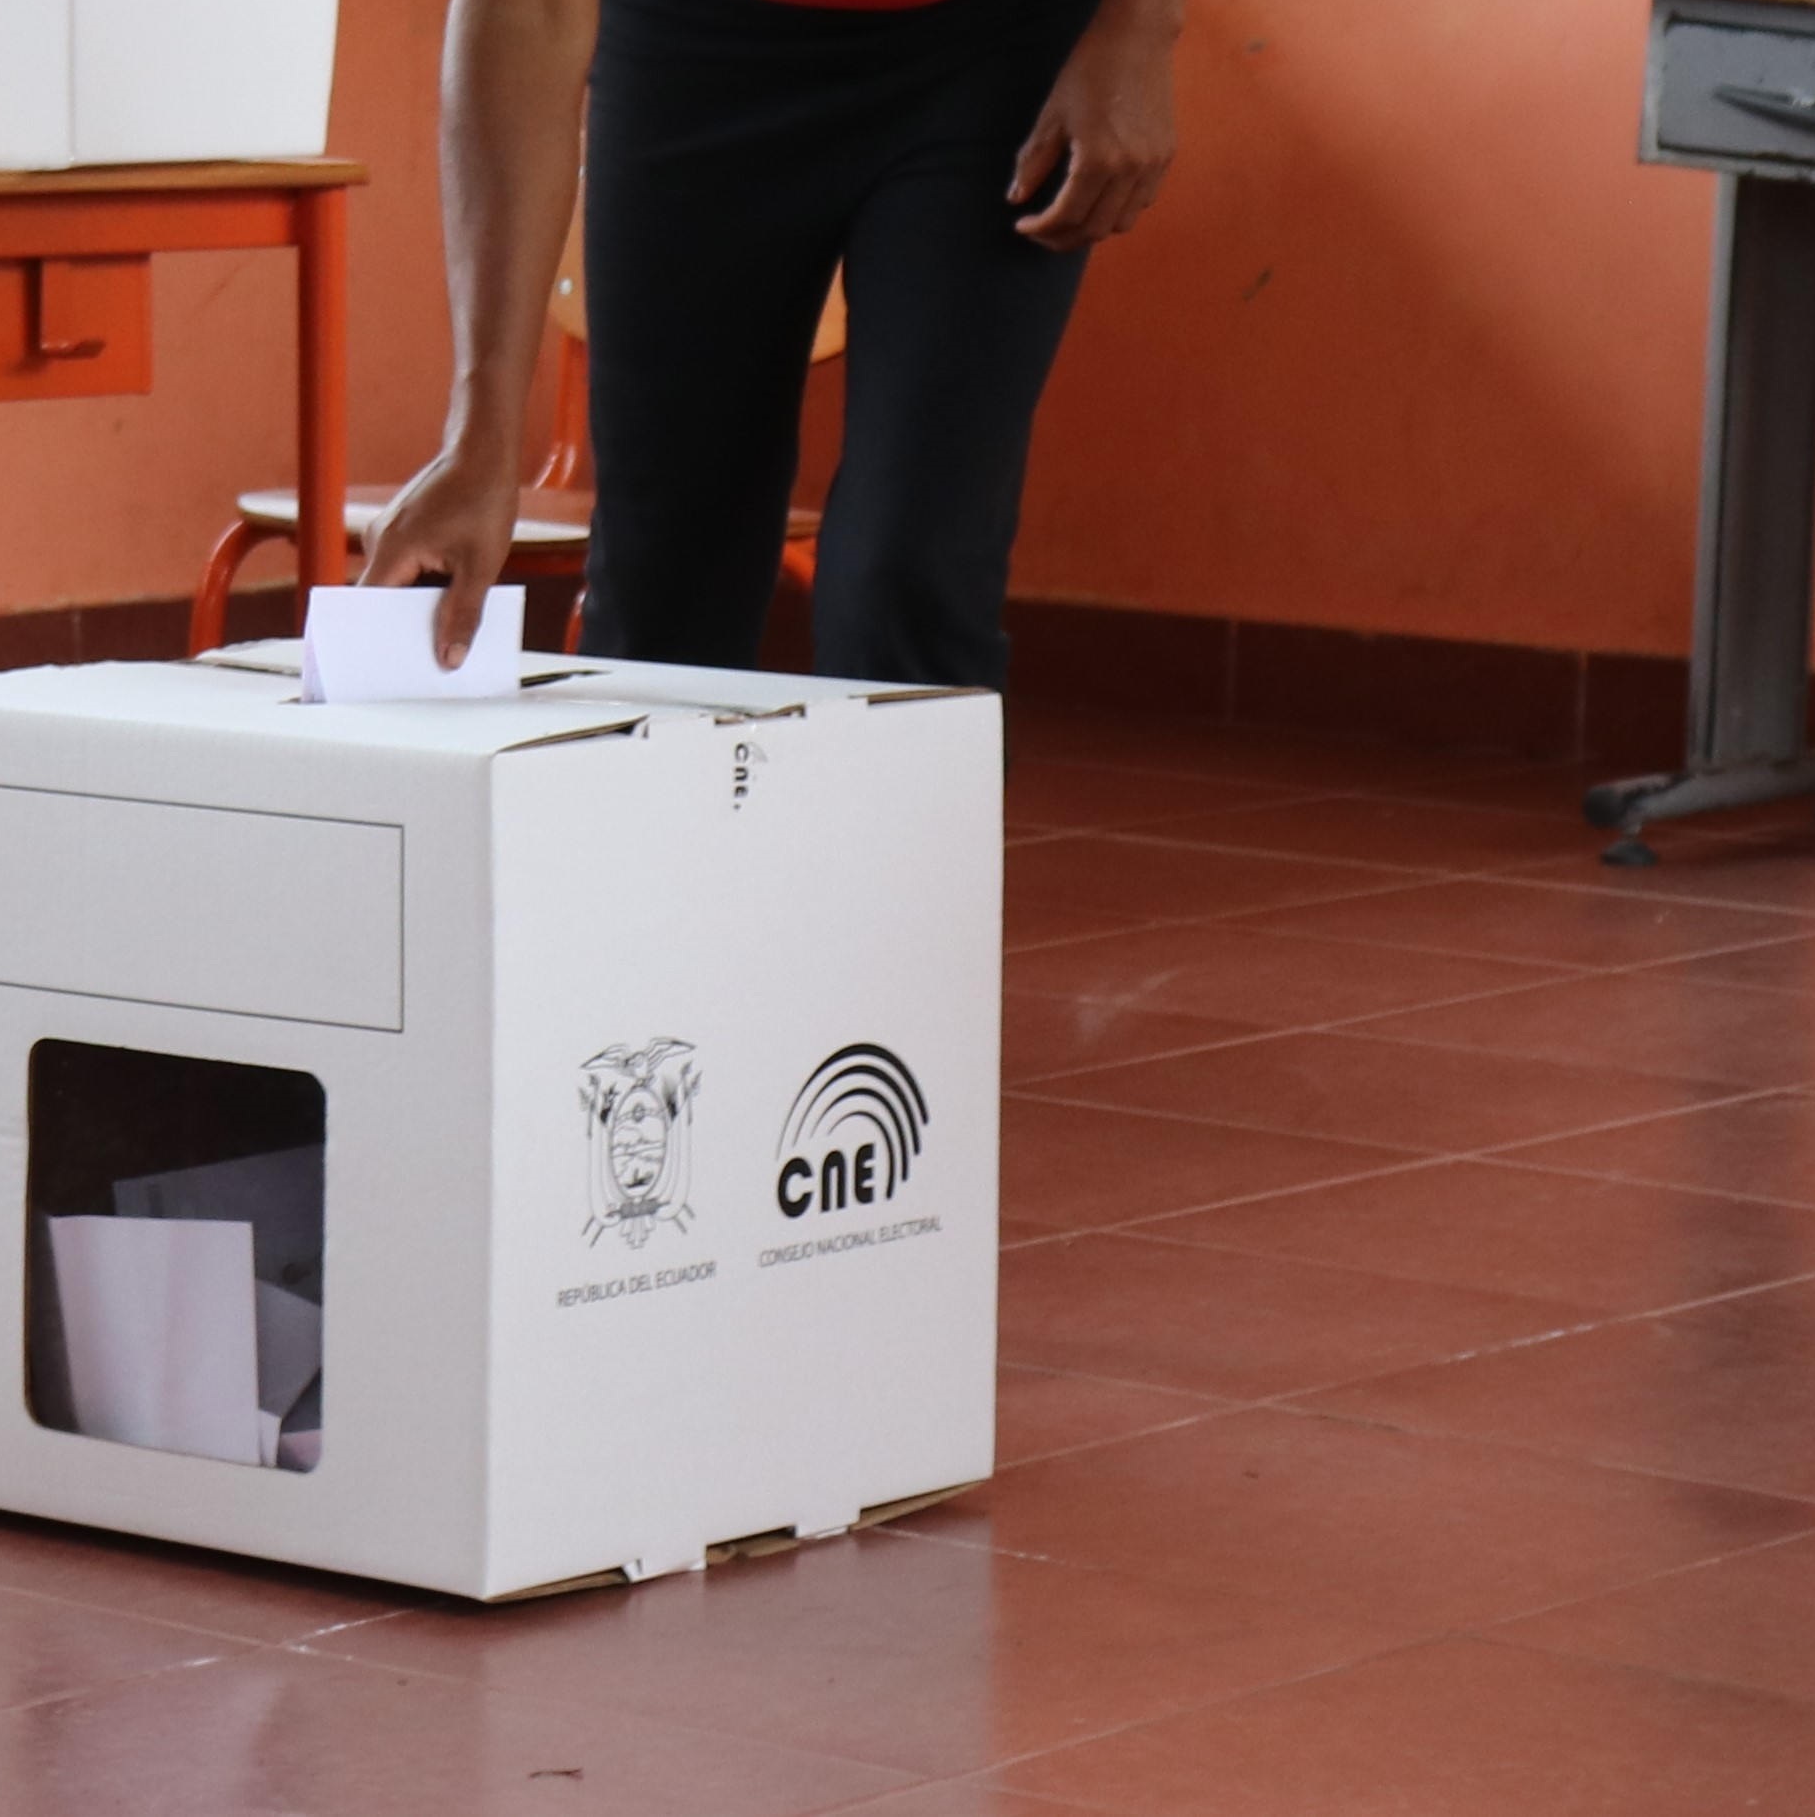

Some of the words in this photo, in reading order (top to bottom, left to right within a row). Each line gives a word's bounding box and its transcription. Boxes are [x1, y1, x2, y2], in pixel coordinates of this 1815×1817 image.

[759, 1240, 813, 1268] CONSEJO
[817, 1230, 876, 1254] NACIONAL
[879, 1216, 943, 1243] ELECTORAL
[629, 1274, 652, 1295] DEL
[656, 1261, 717, 1290] ECUADOR
